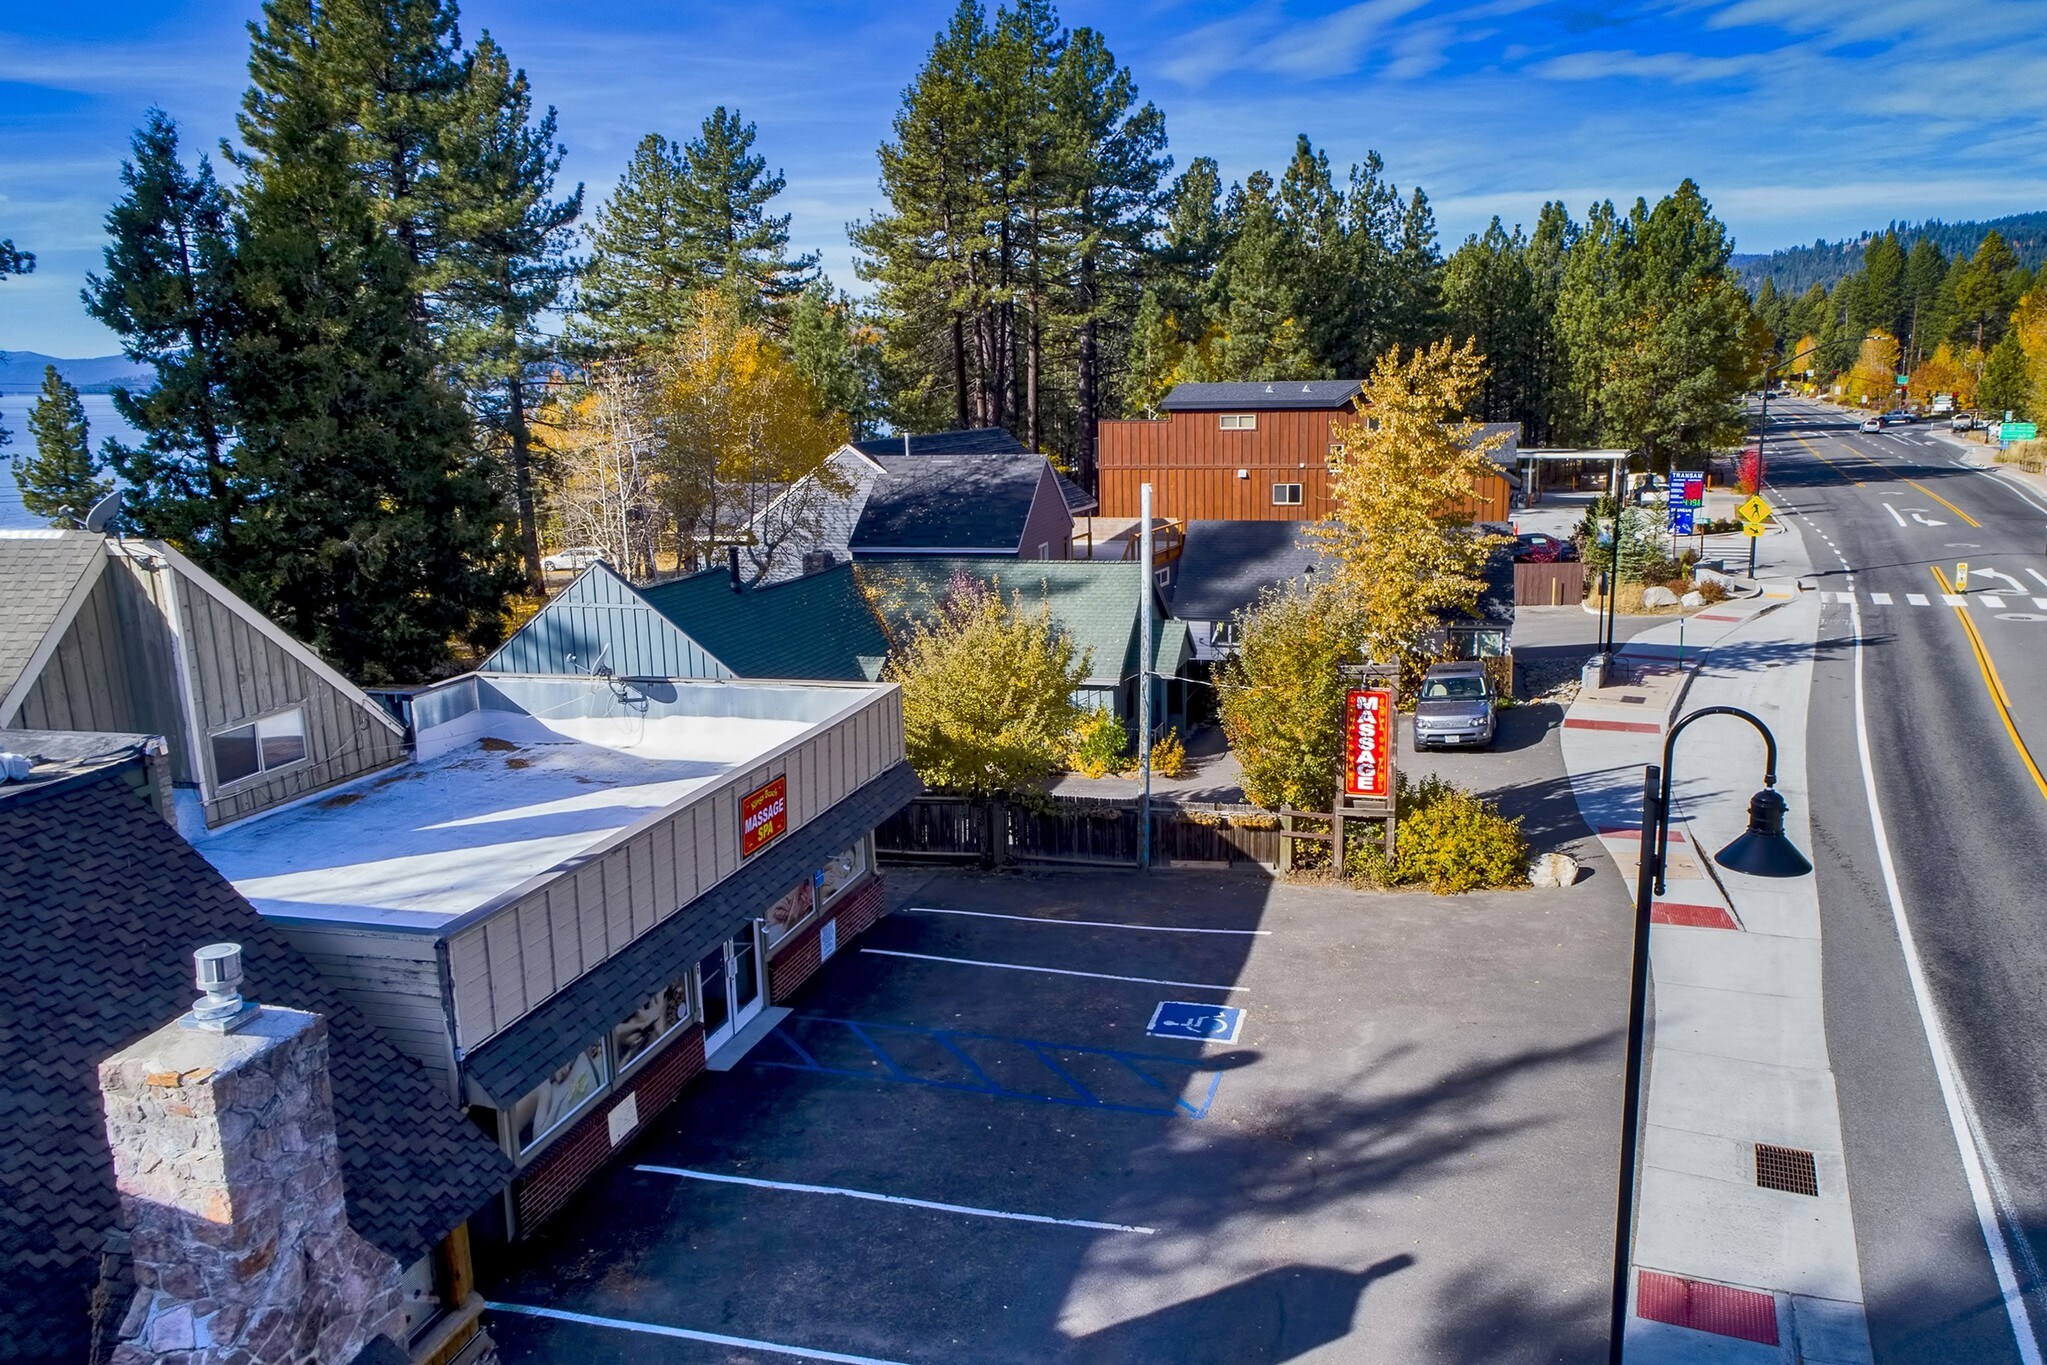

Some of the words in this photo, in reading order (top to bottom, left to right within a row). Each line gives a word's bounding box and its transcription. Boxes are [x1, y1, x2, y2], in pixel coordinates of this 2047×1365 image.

[1356, 696, 1378, 790] MASSAGE
[745, 798, 784, 834] MASSAGE
[758, 821, 773, 841] SPA
